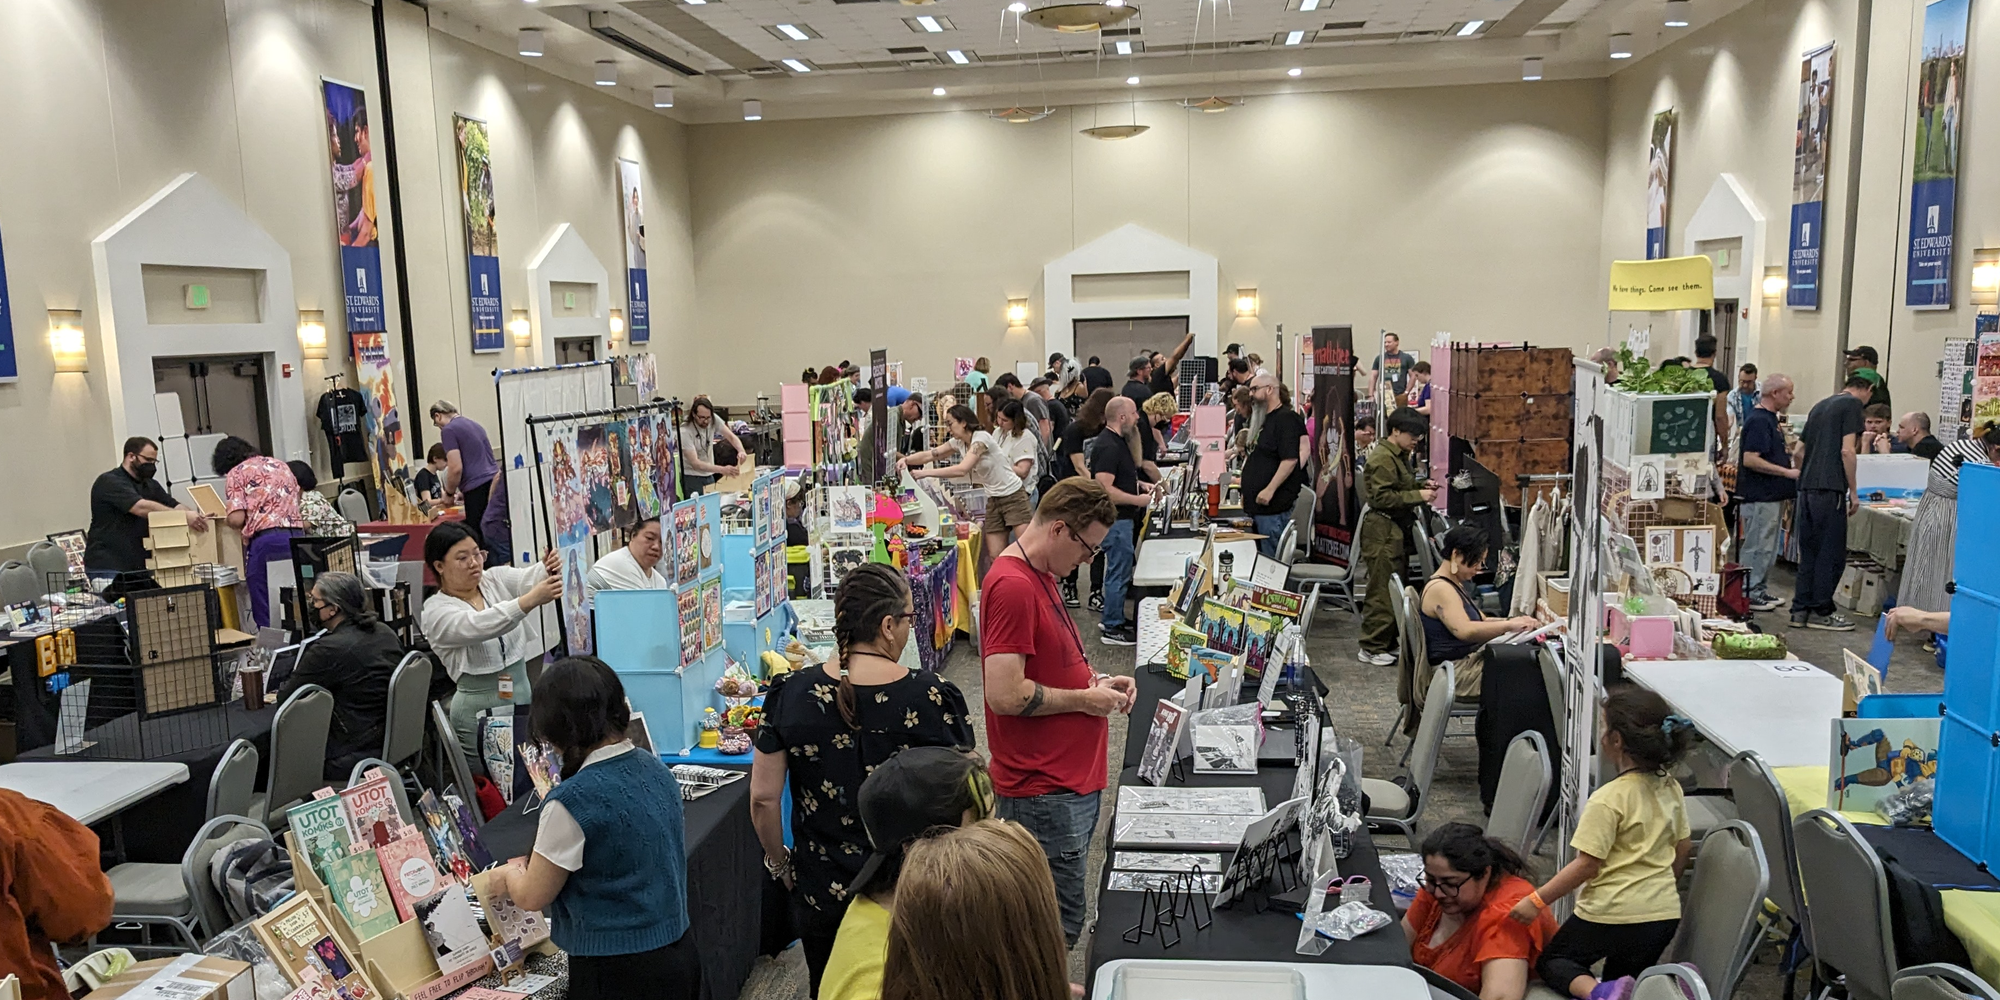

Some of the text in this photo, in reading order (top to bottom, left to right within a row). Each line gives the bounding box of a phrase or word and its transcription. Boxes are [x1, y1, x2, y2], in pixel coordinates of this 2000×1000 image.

[1913, 248, 1951, 258] UNIVERSITY
[1619, 285, 1628, 293] have
[1630, 286, 1646, 295] things.
[1648, 285, 1664, 293] Come
[1682, 282, 1702, 290] them.
[352, 785, 388, 809] UTOT
[298, 804, 339, 829] UTOT
[301, 820, 334, 838] KOMIKS
[353, 886, 370, 898] UTOT
[295, 926, 316, 943] STICKERS
[414, 990, 428, 1000] FEEL
[428, 982, 442, 995] FREE
[444, 979, 451, 988] TO
[453, 973, 464, 984] FLIP
